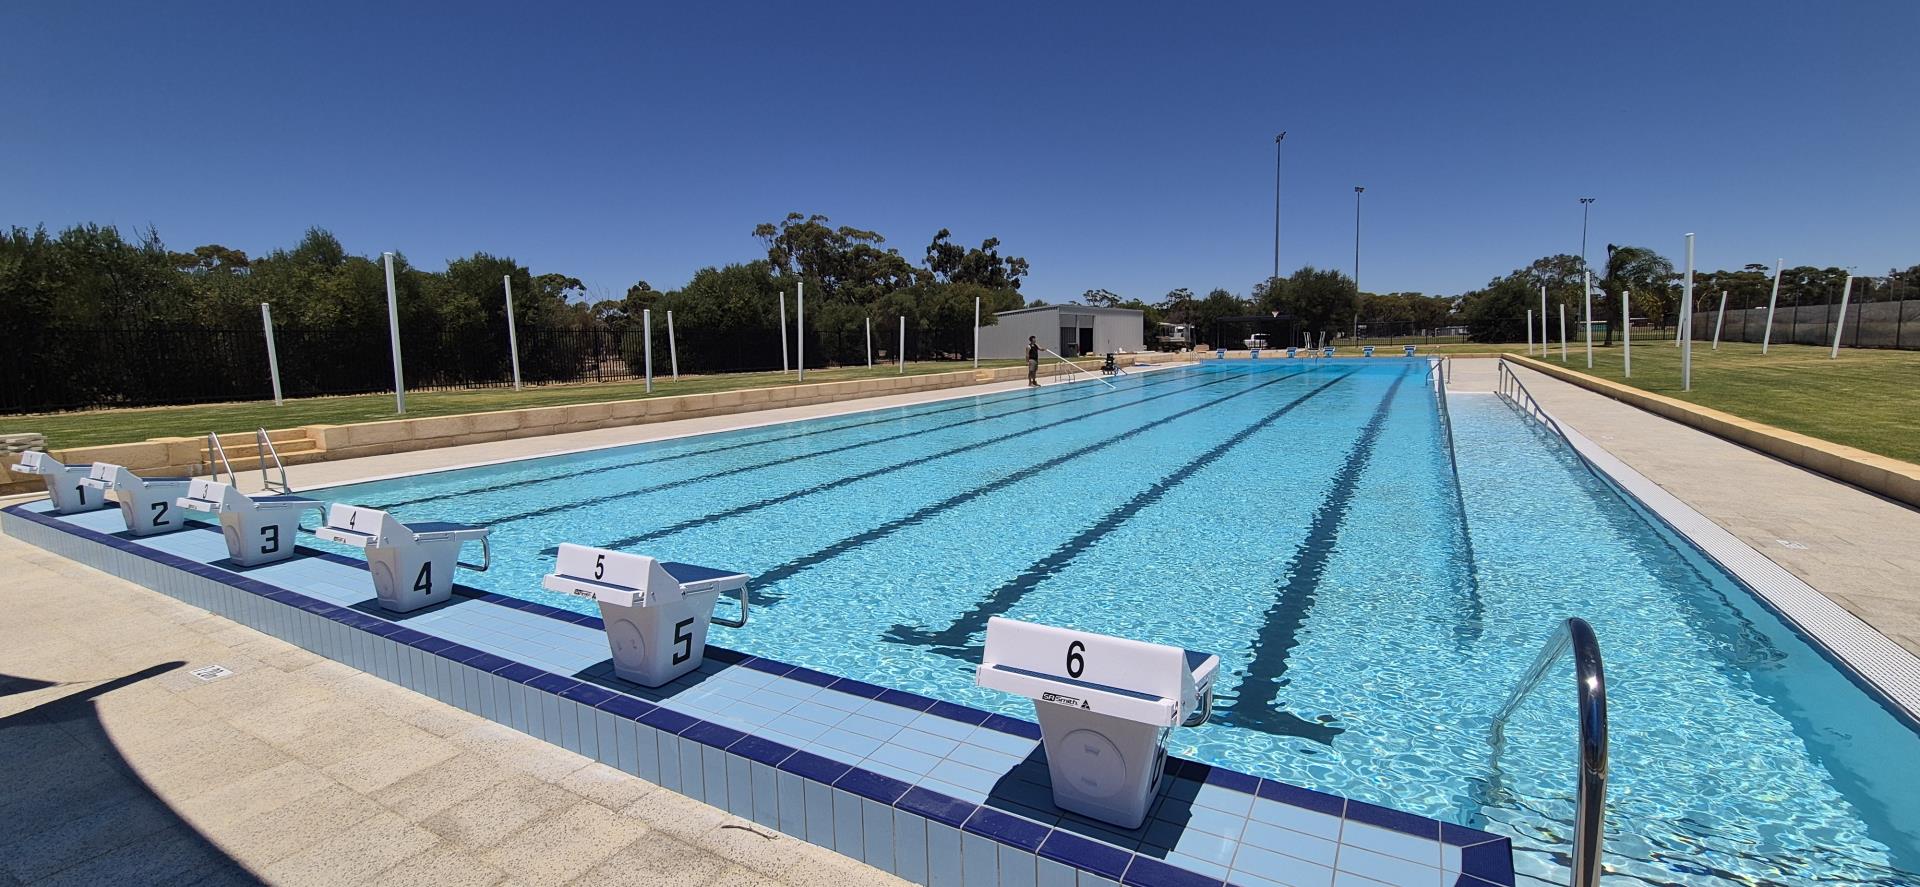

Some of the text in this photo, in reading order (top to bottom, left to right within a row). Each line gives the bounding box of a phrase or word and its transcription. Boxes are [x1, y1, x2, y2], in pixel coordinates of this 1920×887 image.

[75, 485, 86, 506] 1
[203, 483, 209, 499] 3
[151, 501, 170, 527] 2
[349, 510, 357, 529] 4
[260, 524, 279, 554] 3
[413, 560, 433, 596] 4
[594, 554, 605, 580] 5
[672, 617, 695, 666] 5
[1066, 640, 1086, 679] 6
